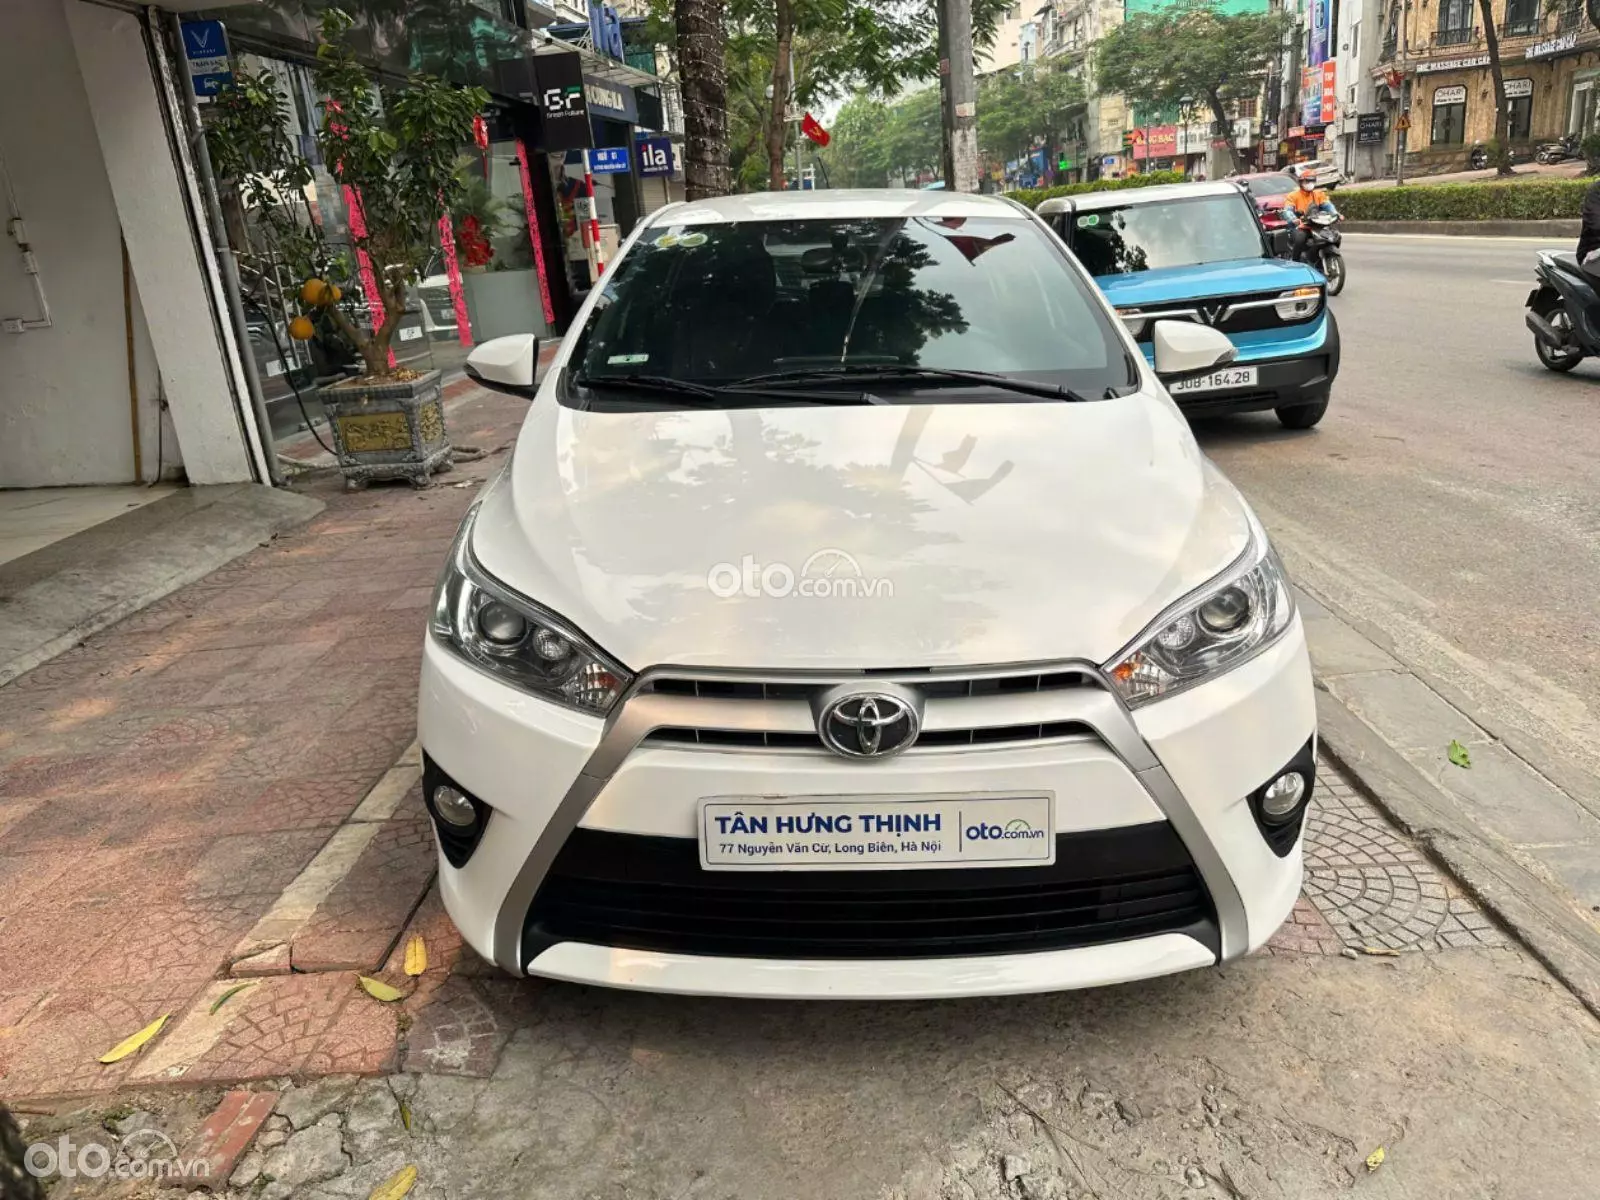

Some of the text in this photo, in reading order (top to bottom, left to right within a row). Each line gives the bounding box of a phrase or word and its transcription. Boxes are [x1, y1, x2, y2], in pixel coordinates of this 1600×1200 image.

[641, 144, 667, 166] ila
[714, 810, 941, 837] TÂN HƯNG THỊNH
[966, 821, 1044, 840] oto.com.vn
[719, 843, 735, 854] 77
[738, 842, 784, 856] Nguyễn
[786, 842, 809, 853] Văn
[835, 842, 865, 855] Long
[868, 840, 898, 855] Biên,
[901, 840, 917, 853] Hà
[920, 839, 941, 853] Nội
